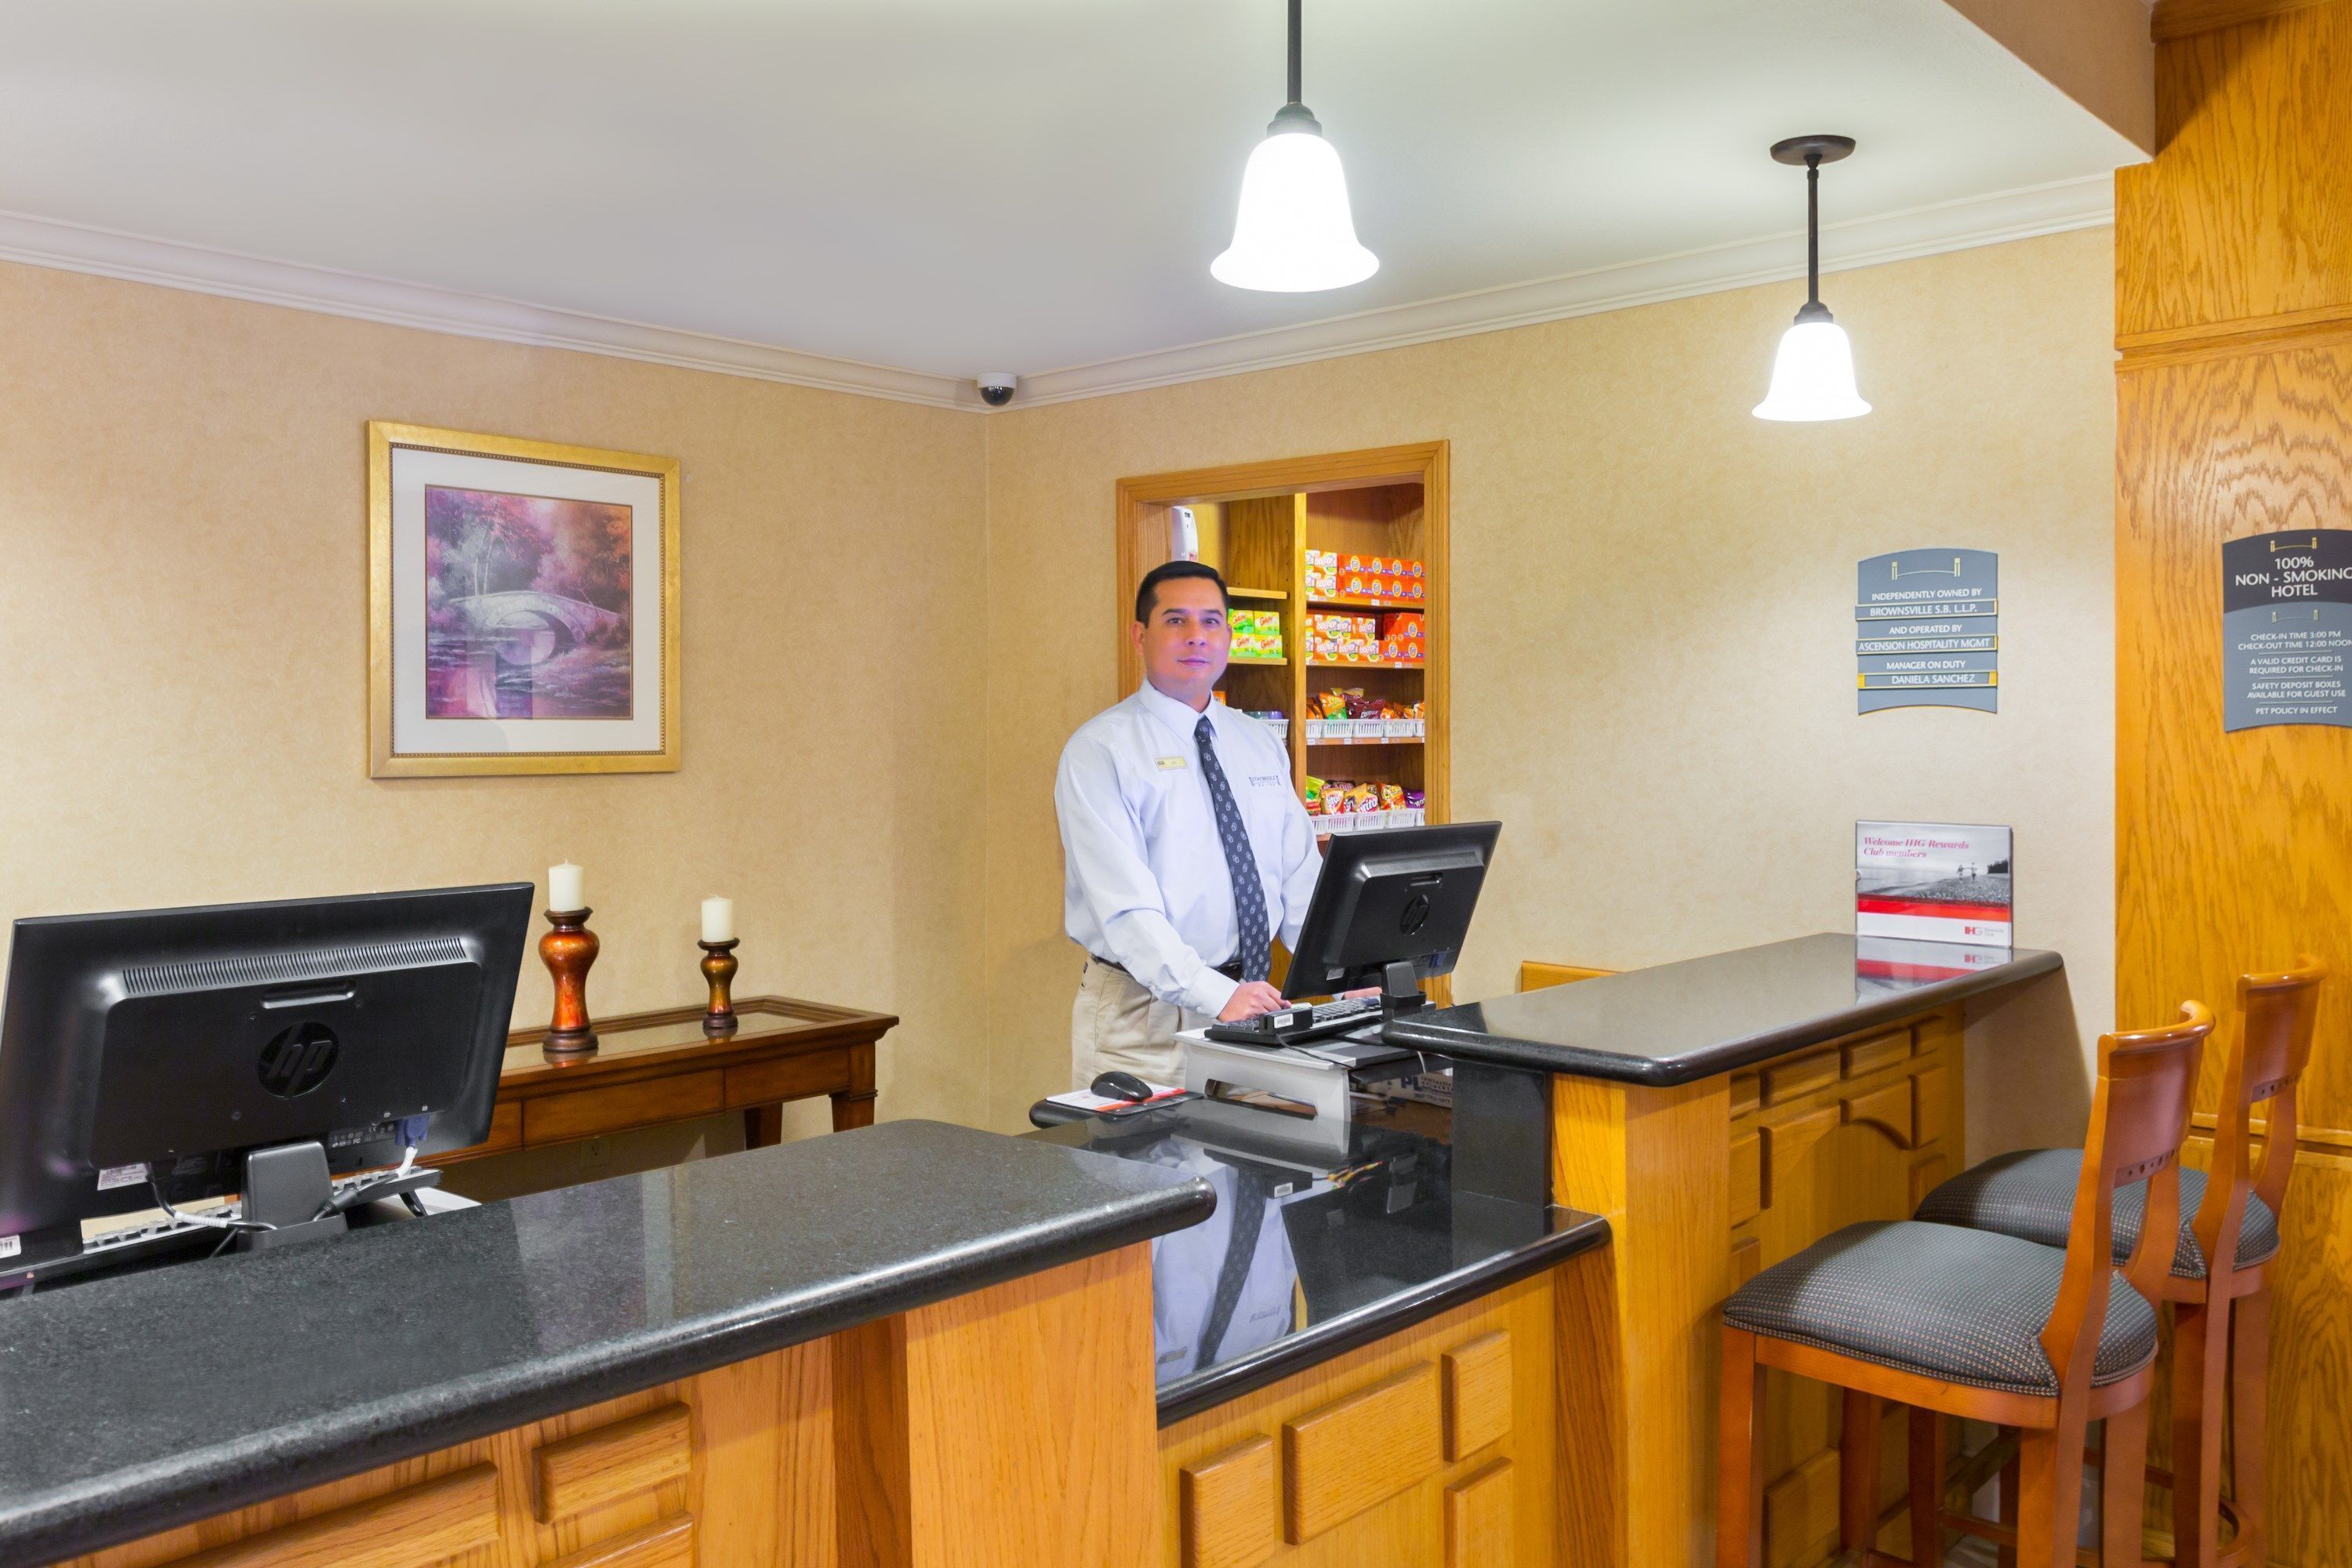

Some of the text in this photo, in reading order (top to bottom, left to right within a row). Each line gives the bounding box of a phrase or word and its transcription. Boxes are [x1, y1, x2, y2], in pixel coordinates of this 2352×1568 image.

[2274, 556, 2314, 569] 100%
[2235, 573, 2270, 586] NON
[2283, 567, 2352, 583] SMOKING
[1871, 587, 1982, 601] INDEPENDENTLY OWNED BY
[2271, 584, 2318, 597] HOTEL
[1870, 604, 1977, 616] BROWNSVILLE S.B. L.L.P.
[1909, 625, 1949, 633] OPERATED
[1951, 624, 1962, 633] BY
[1858, 638, 1990, 651] ASCENSION HOSPITALITY MGMT
[1886, 661, 1926, 670] MANAGER
[1943, 660, 1966, 669] DUTY
[1892, 674, 1975, 684] DANIELA SANCHEZ
[1864, 837, 1903, 846] Welcome
[1928, 840, 1969, 849] Rewards
[1886, 849, 1927, 858] members
[1965, 926, 1983, 935] IHG
[266, 1022, 332, 1098] hp
